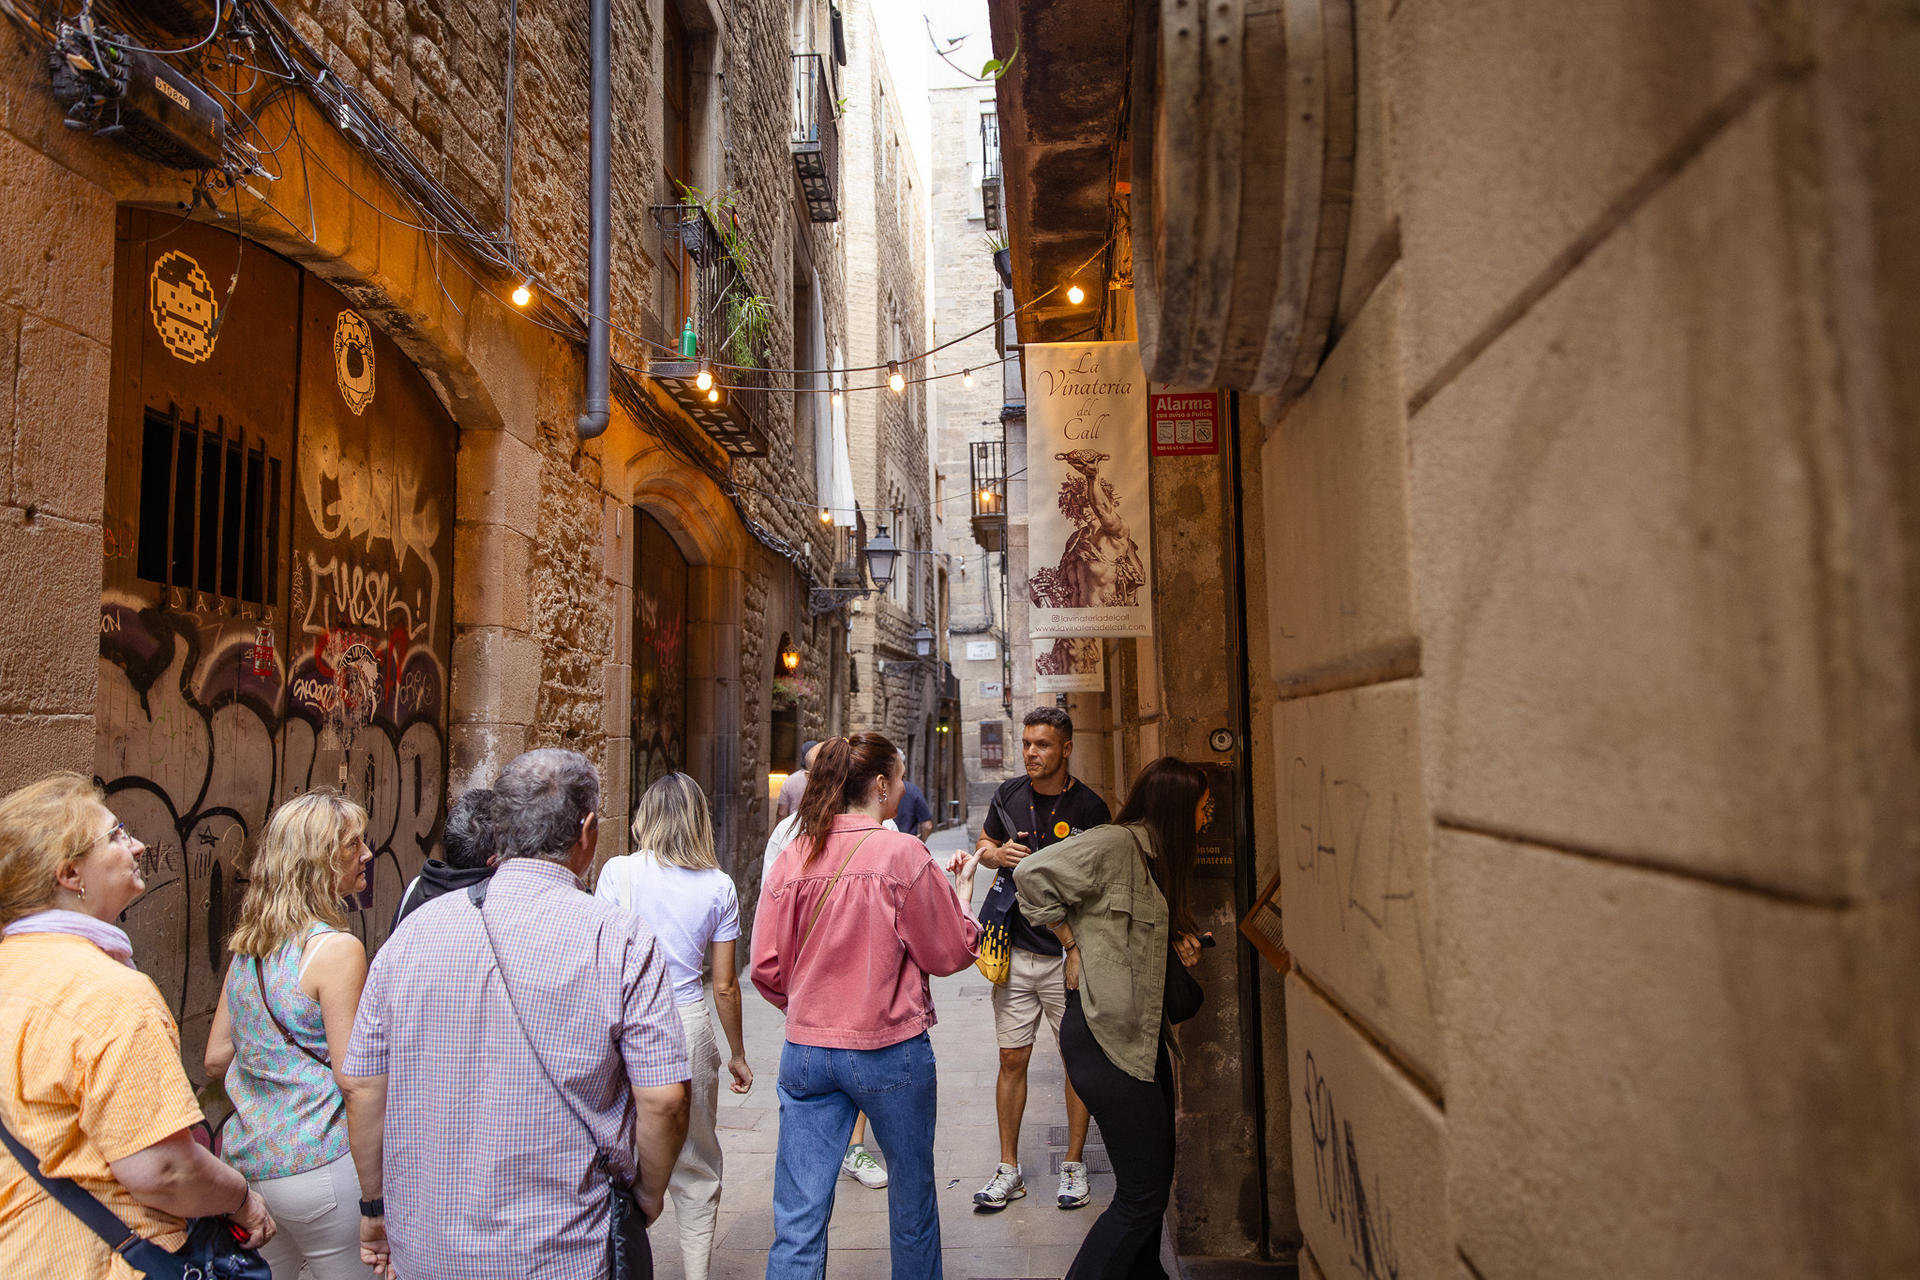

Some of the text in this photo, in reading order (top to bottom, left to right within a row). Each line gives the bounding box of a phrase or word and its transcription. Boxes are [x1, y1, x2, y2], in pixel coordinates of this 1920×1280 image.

[1068, 352, 1100, 375] La
[1076, 397, 1099, 417] del
[1156, 396, 1213, 411] Alarma
[1064, 413, 1110, 440] Call
